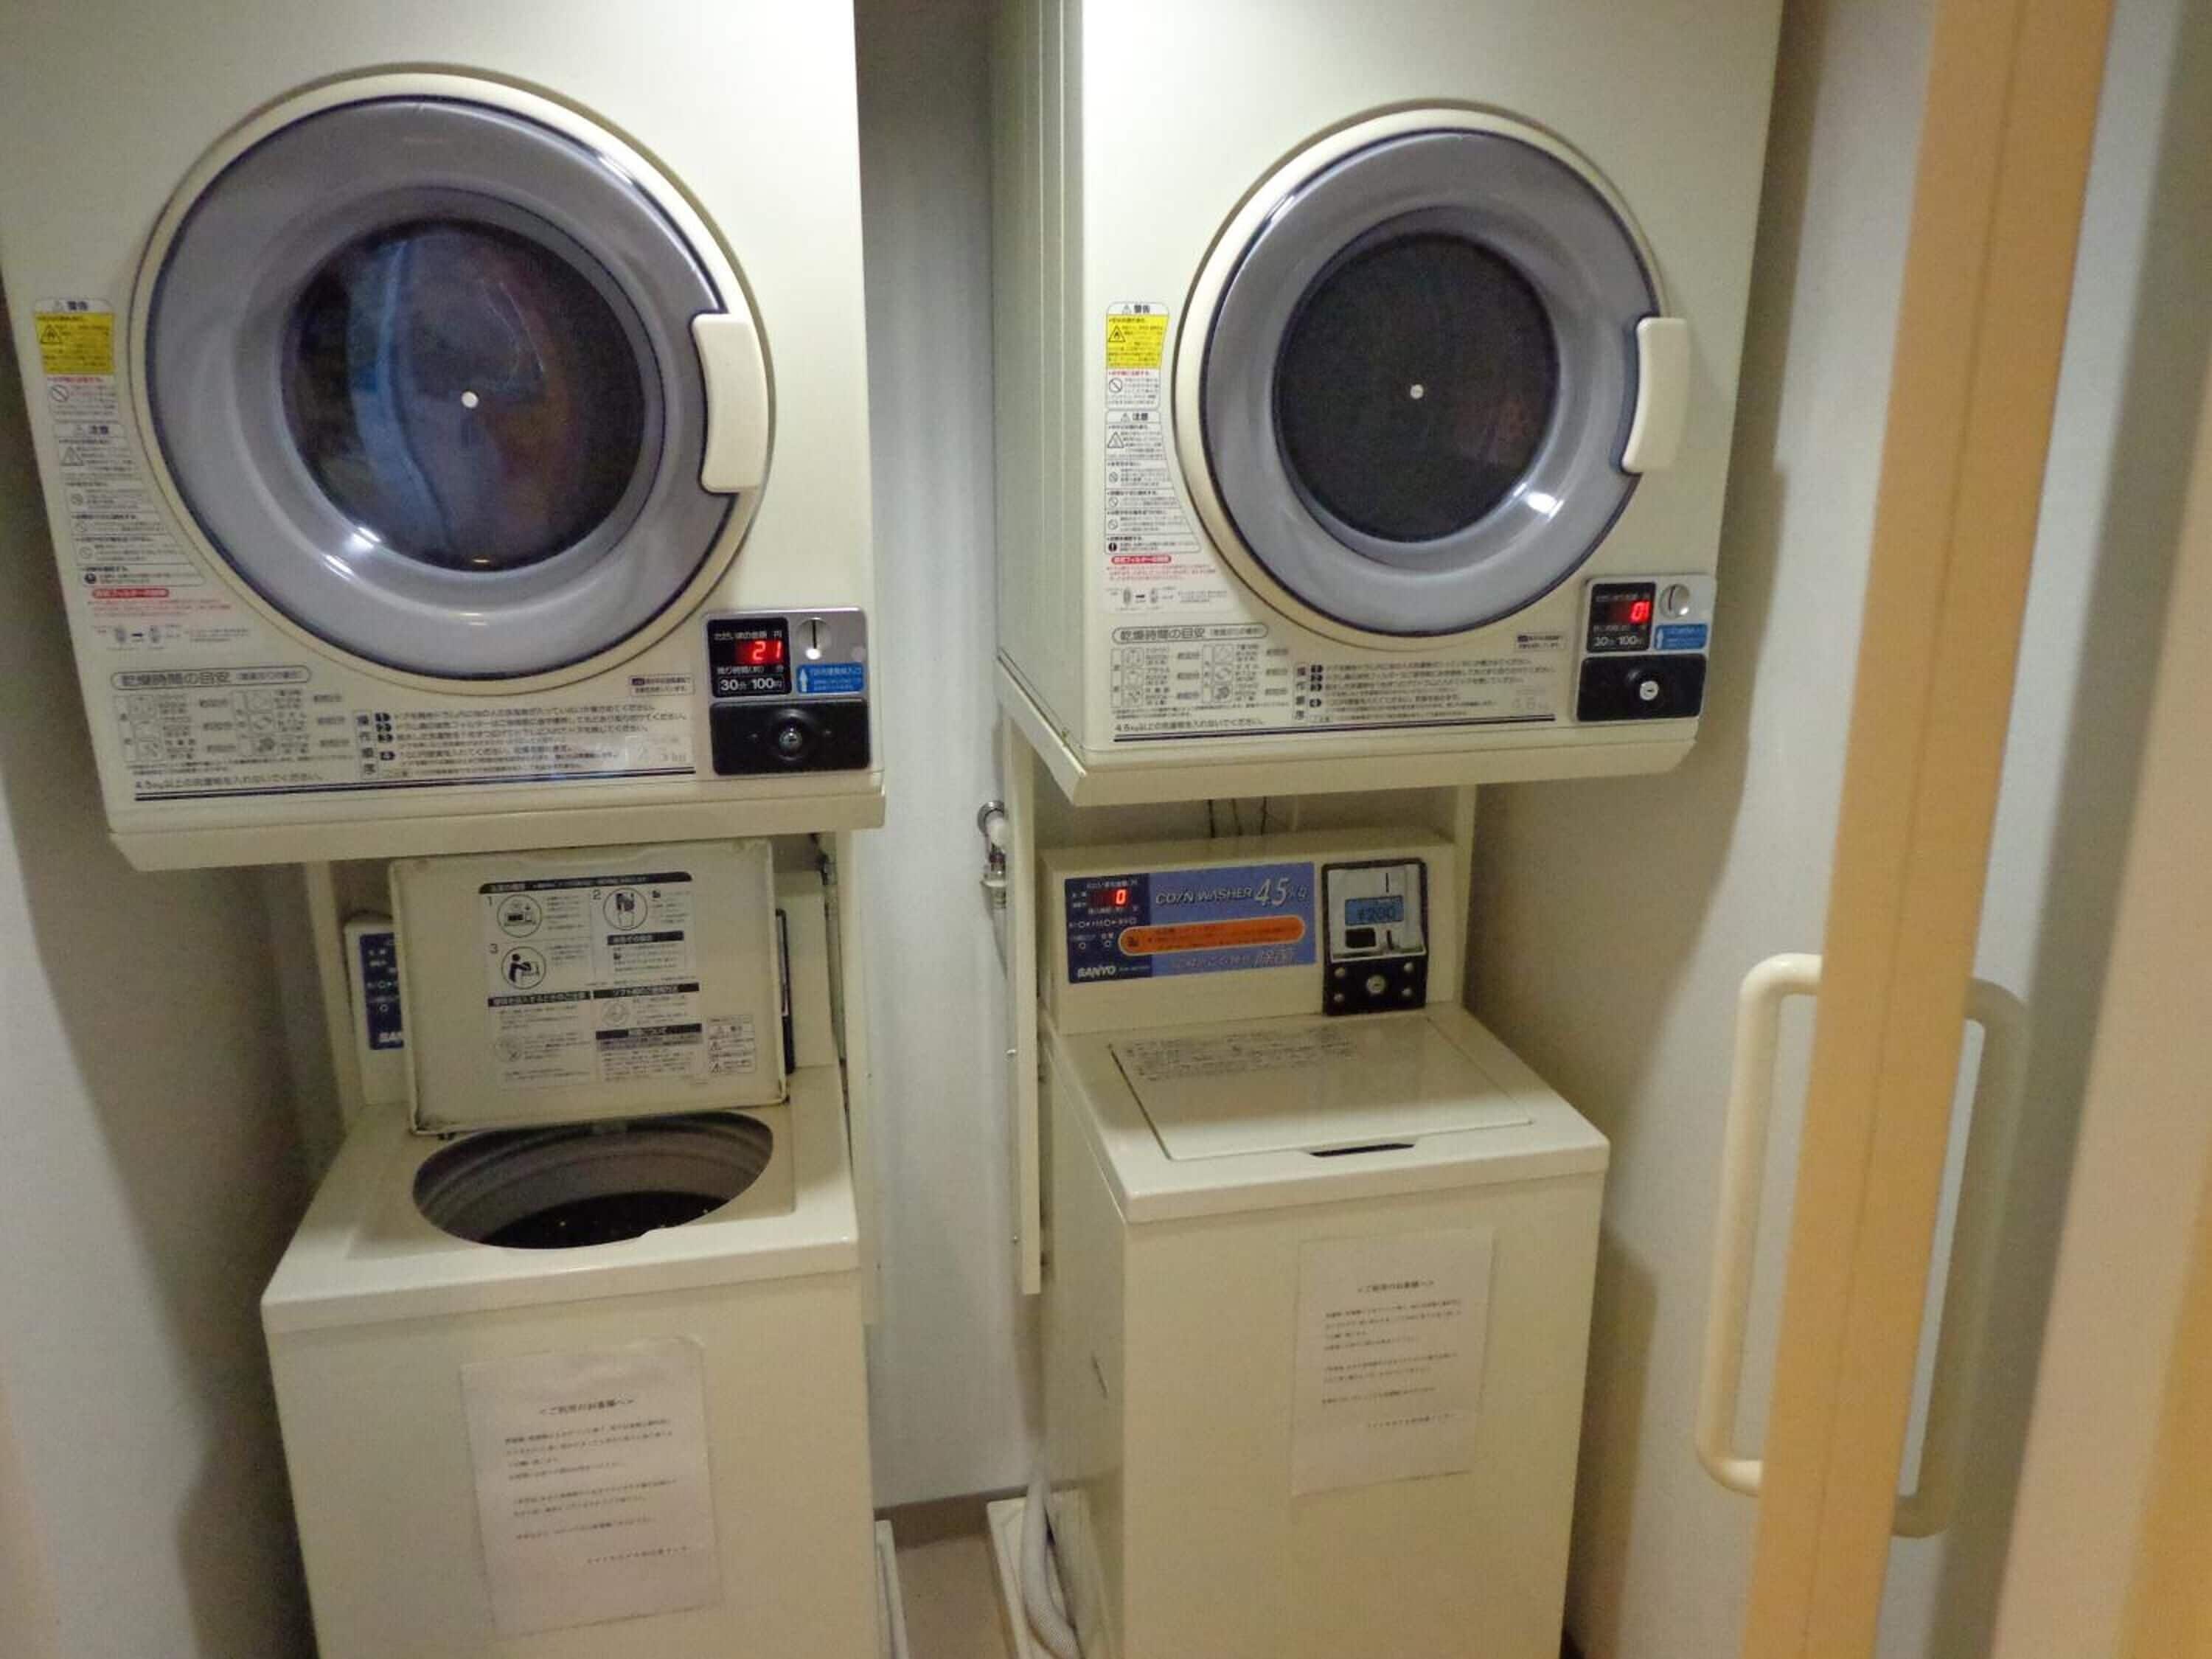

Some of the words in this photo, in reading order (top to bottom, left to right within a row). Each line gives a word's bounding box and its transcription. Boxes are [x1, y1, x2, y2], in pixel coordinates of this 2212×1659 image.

[752, 640, 783, 661] 21
[1116, 888, 1127, 905] 0
[1077, 965, 1116, 979] SANYO
